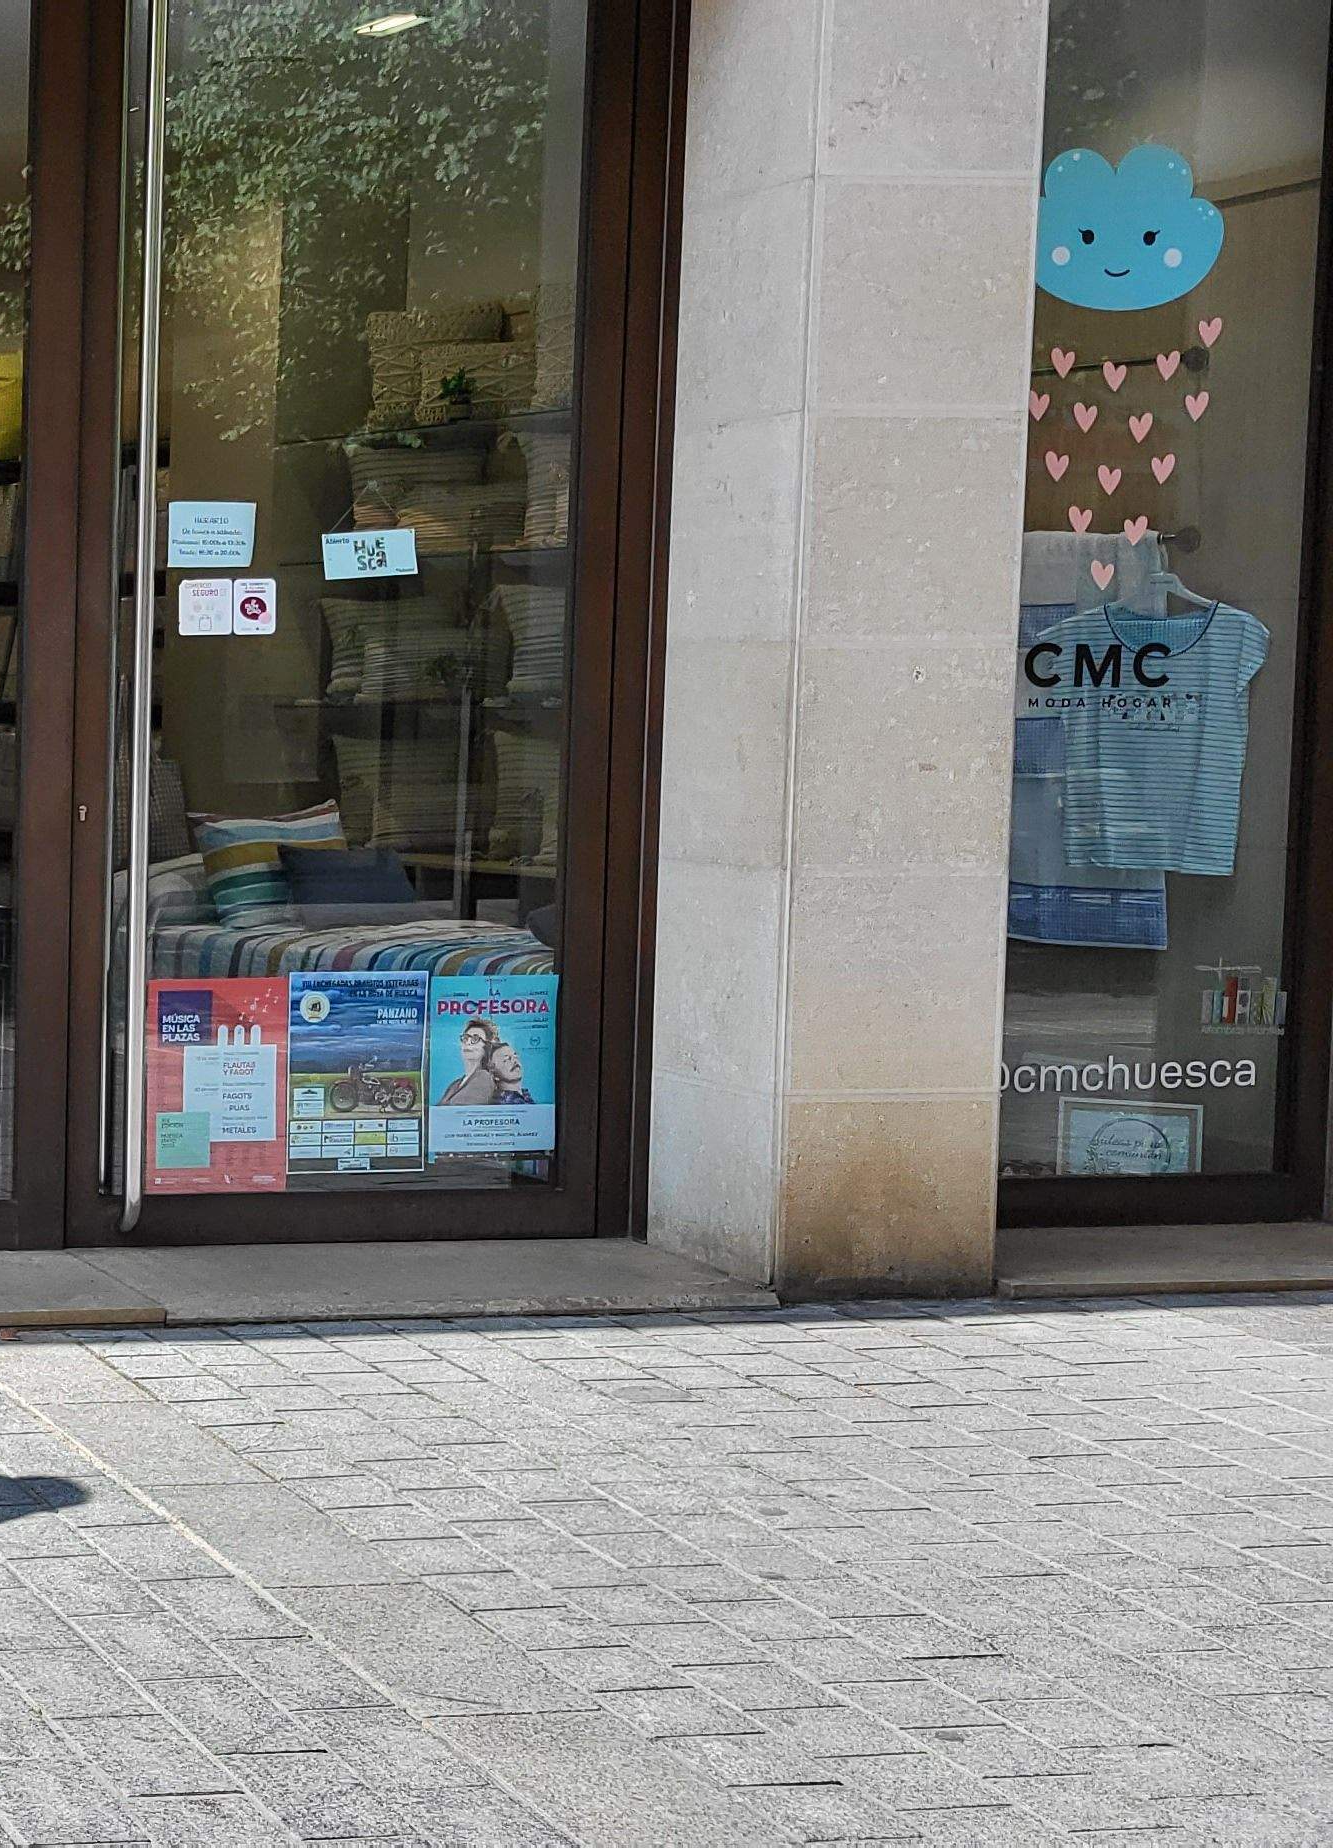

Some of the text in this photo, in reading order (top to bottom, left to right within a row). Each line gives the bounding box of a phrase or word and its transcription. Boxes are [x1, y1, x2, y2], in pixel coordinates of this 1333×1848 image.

[1025, 643, 1171, 688] CMC
[1028, 697, 1171, 708] MODA HOGAR
[437, 999, 549, 1015] PROFESORA
[162, 1013, 201, 1023] MÚSICA
[377, 1008, 418, 1019] PANZANO
[162, 1034, 201, 1042] PLAZAS
